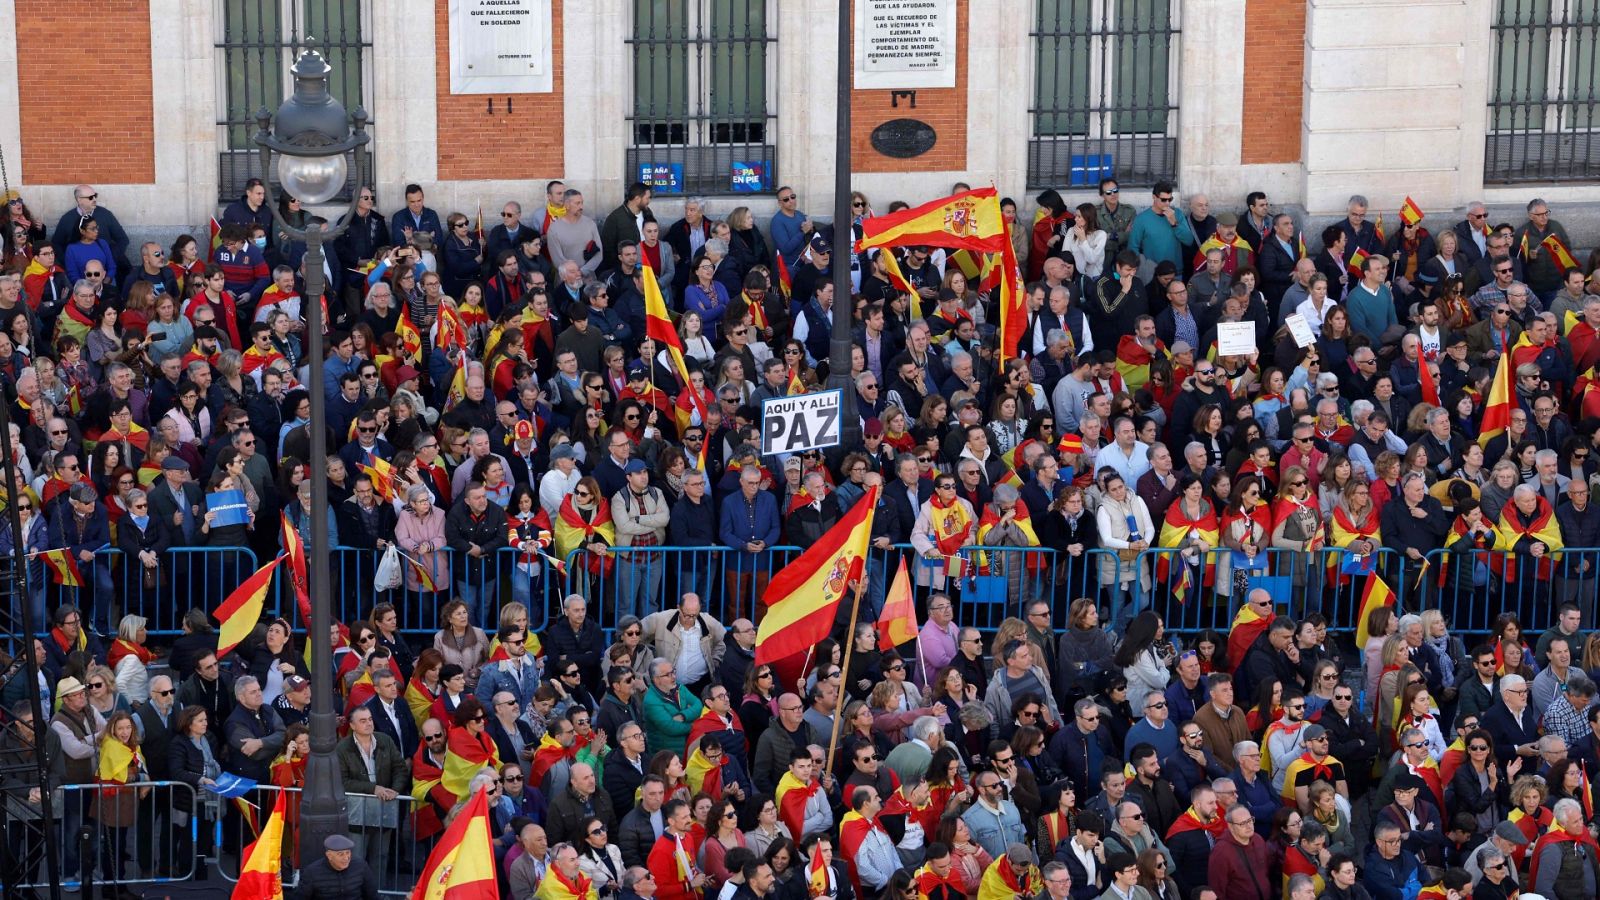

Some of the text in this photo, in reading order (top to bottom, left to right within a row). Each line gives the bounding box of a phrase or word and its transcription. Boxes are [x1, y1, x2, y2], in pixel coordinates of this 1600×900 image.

[733, 175, 760, 184] EN PIE
[220, 252, 230, 261] 19
[766, 394, 838, 415] AQUÍ Y ALLÍ
[764, 407, 838, 453] PAZ
